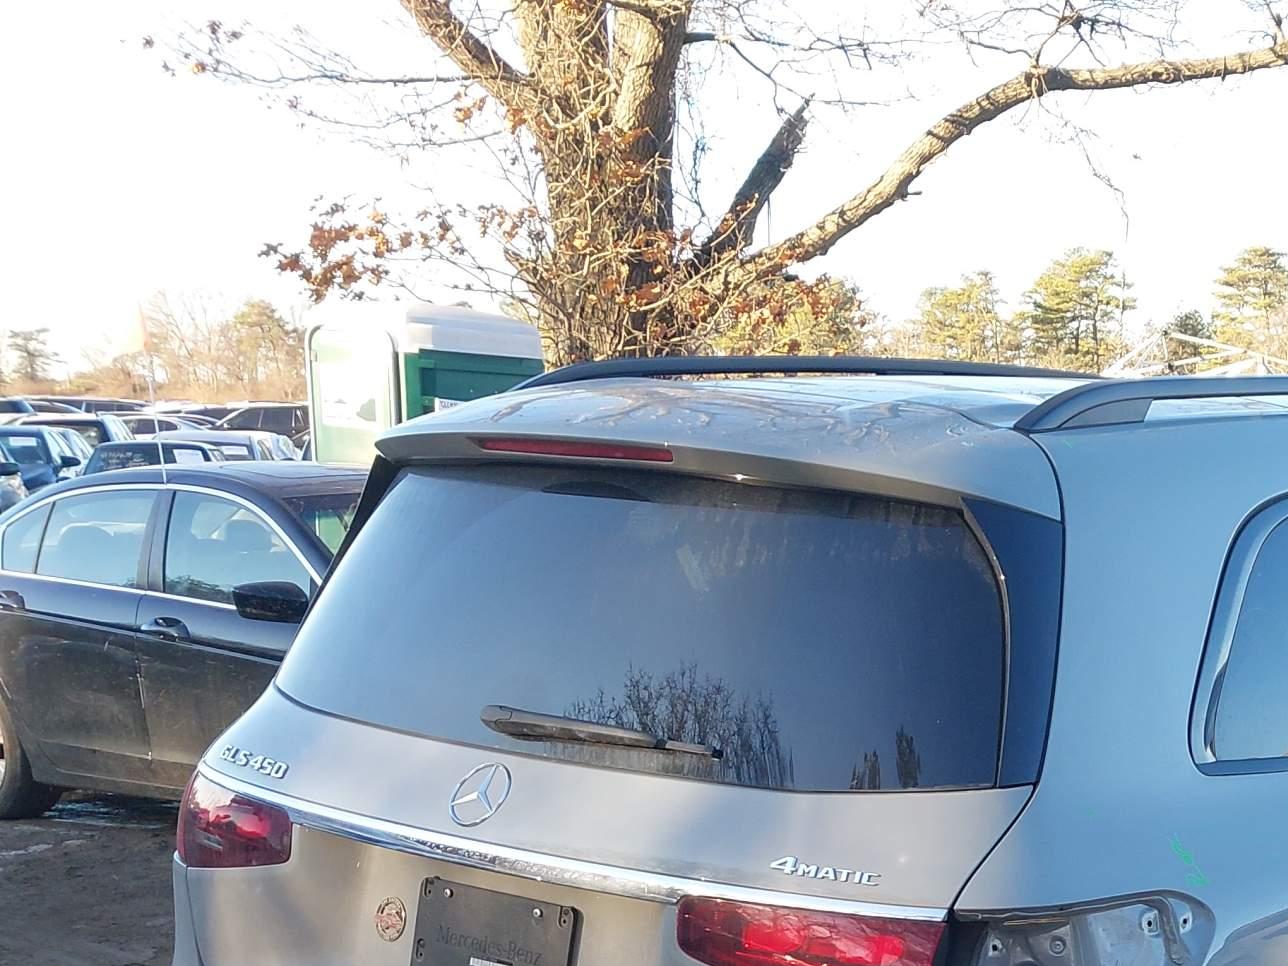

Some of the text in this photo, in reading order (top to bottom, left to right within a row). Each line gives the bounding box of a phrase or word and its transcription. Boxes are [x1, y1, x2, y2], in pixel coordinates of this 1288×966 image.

[220, 744, 289, 779] GLS 450
[769, 856, 882, 886] 4MATIC
